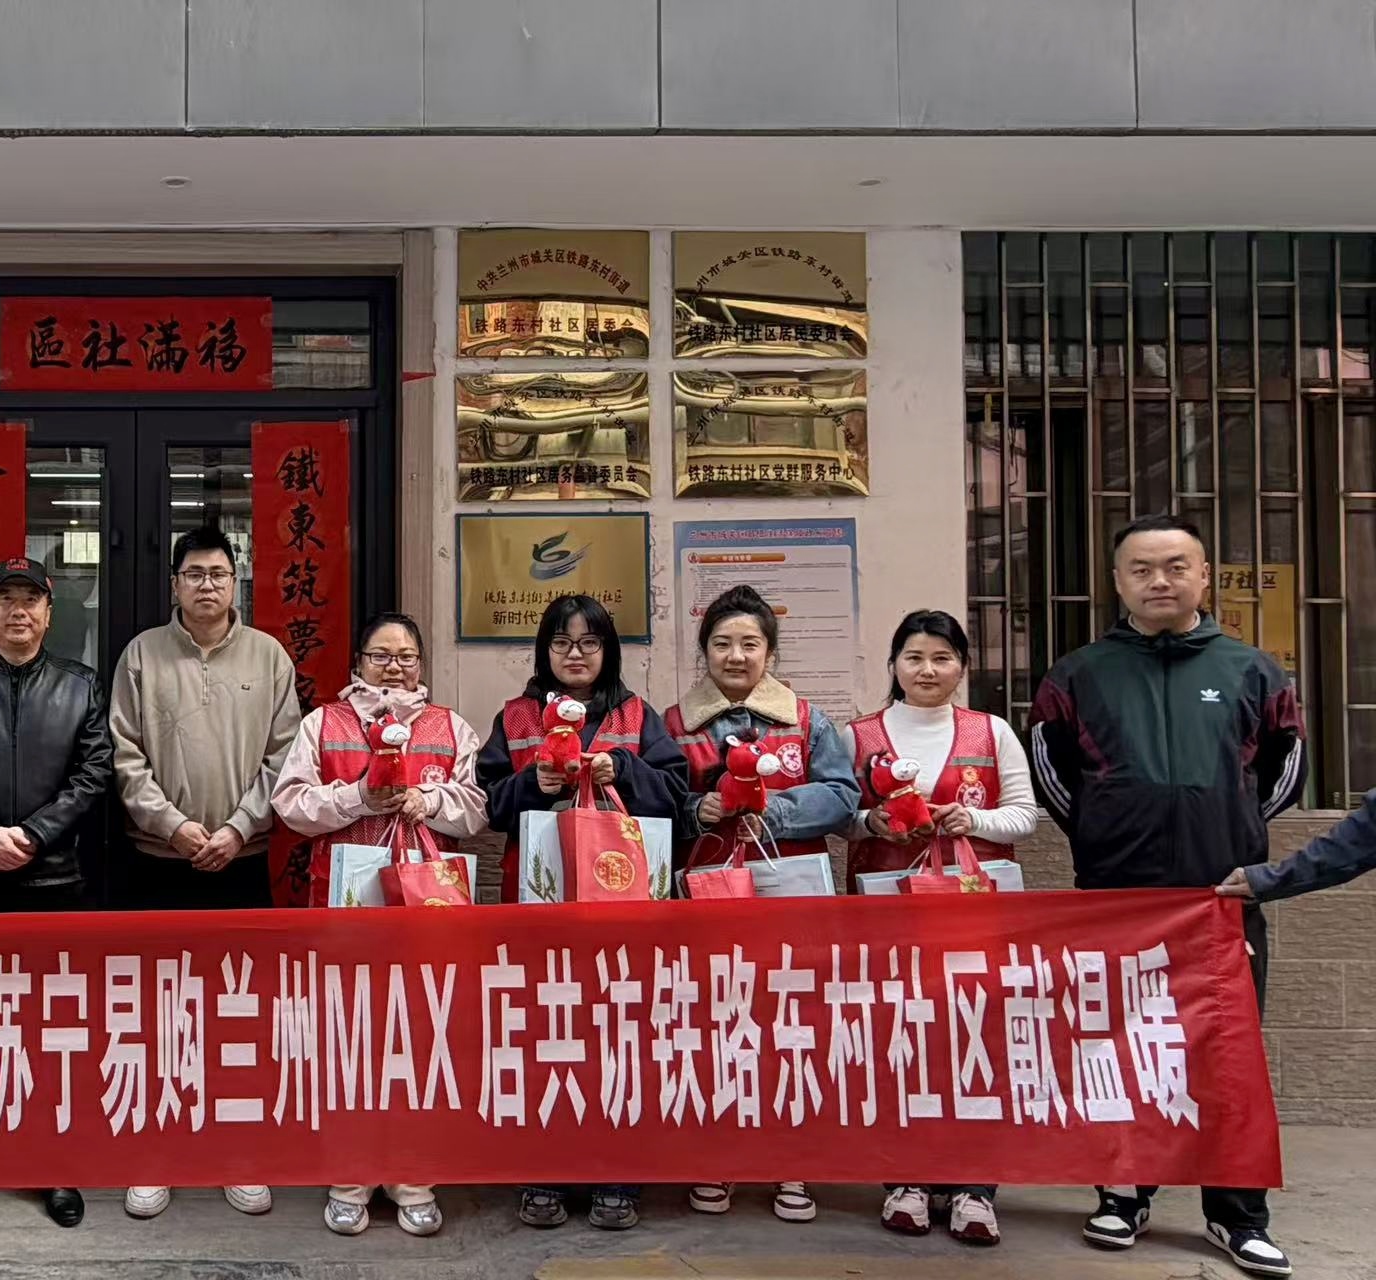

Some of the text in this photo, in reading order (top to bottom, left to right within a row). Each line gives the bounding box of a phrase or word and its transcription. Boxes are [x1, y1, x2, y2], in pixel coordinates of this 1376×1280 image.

[688, 323, 855, 342] 铁路东村社区居民委员会
[687, 463, 856, 483] 铁路东村社区党群服务中心
